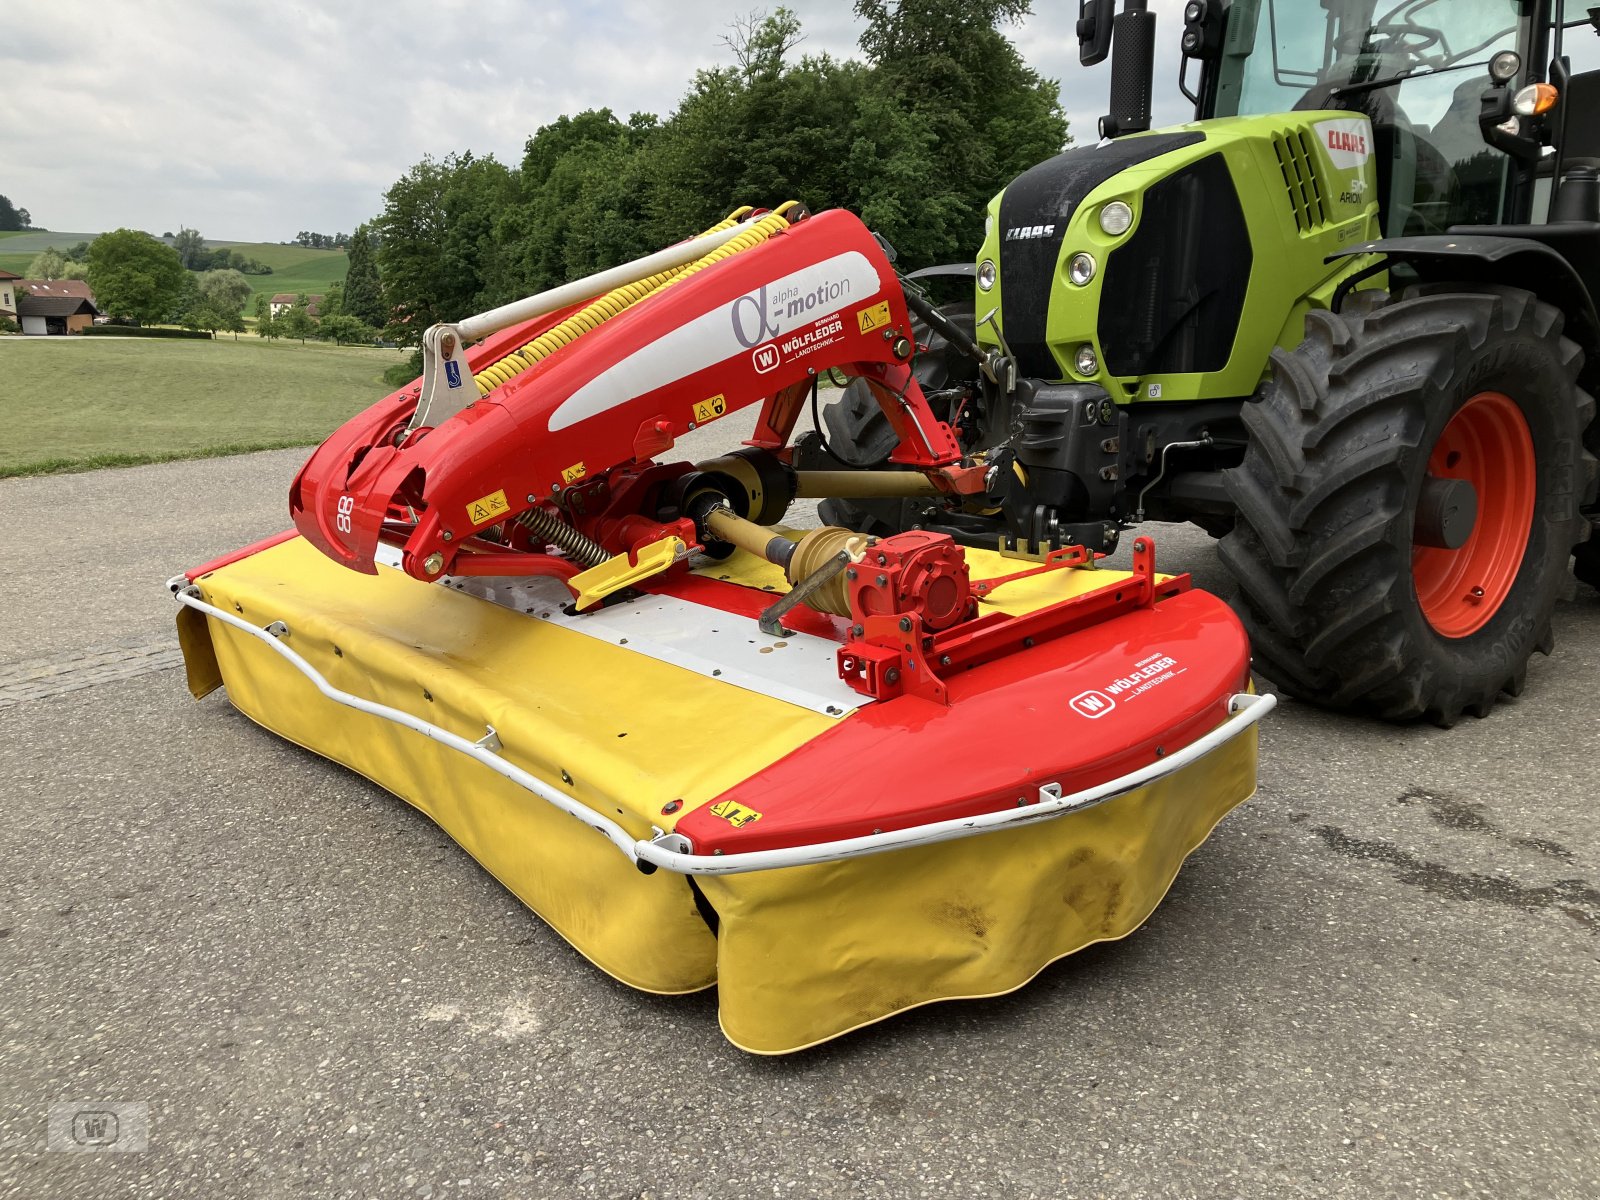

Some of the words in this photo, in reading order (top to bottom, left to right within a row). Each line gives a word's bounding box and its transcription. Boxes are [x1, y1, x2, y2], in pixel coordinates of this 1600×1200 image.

[1328, 130, 1366, 155] CLAAS
[1340, 191, 1362, 205] ARION
[1005, 224, 1056, 242] CLAAS
[772, 286, 799, 305] alpha
[815, 313, 840, 327] BERNHARD
[781, 320, 843, 354] WÖLFLEDER
[795, 337, 835, 359] LANDTECHNIK
[1104, 656, 1178, 695] WÖLFLEDER
[1131, 670, 1176, 696] LANDTECHNIK
